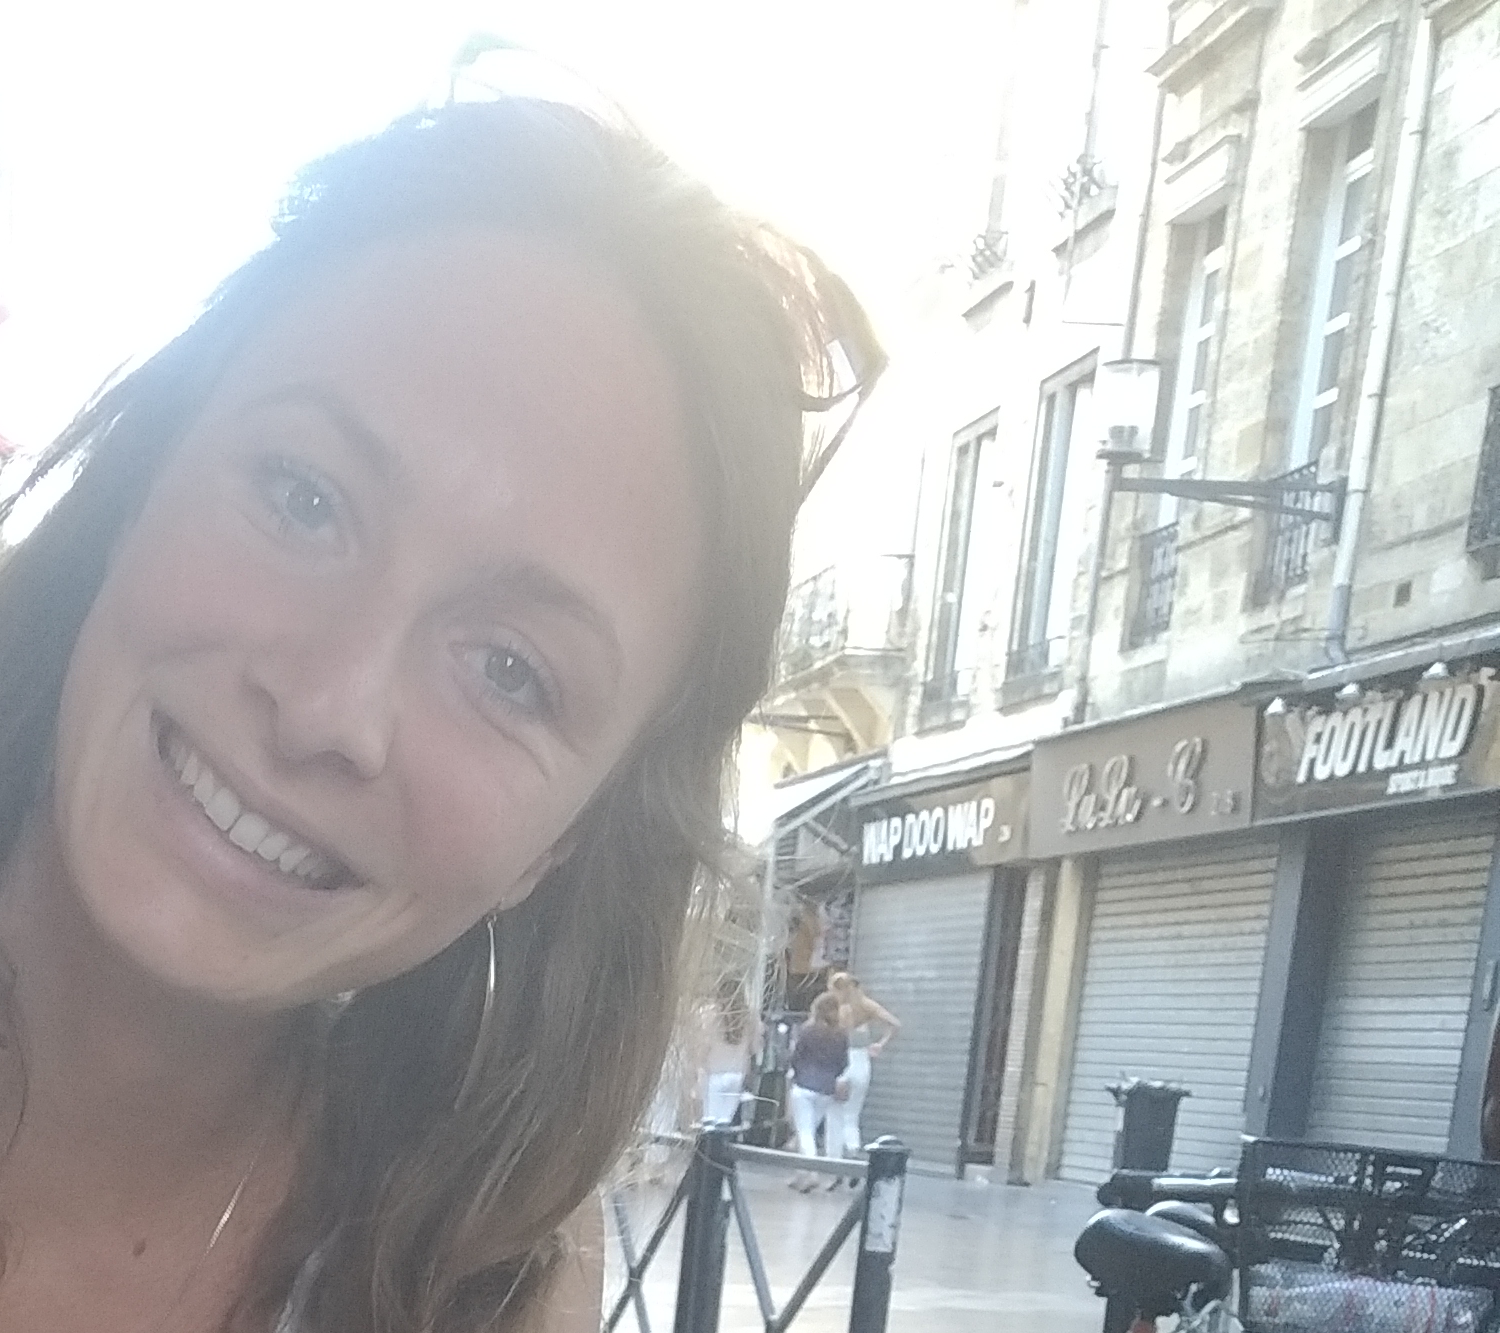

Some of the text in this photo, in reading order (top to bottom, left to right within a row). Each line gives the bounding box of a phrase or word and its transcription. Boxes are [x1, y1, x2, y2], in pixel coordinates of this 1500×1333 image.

[1295, 683, 1478, 784] FOOTLAND
[862, 797, 995, 865] WAP DOO WAP
